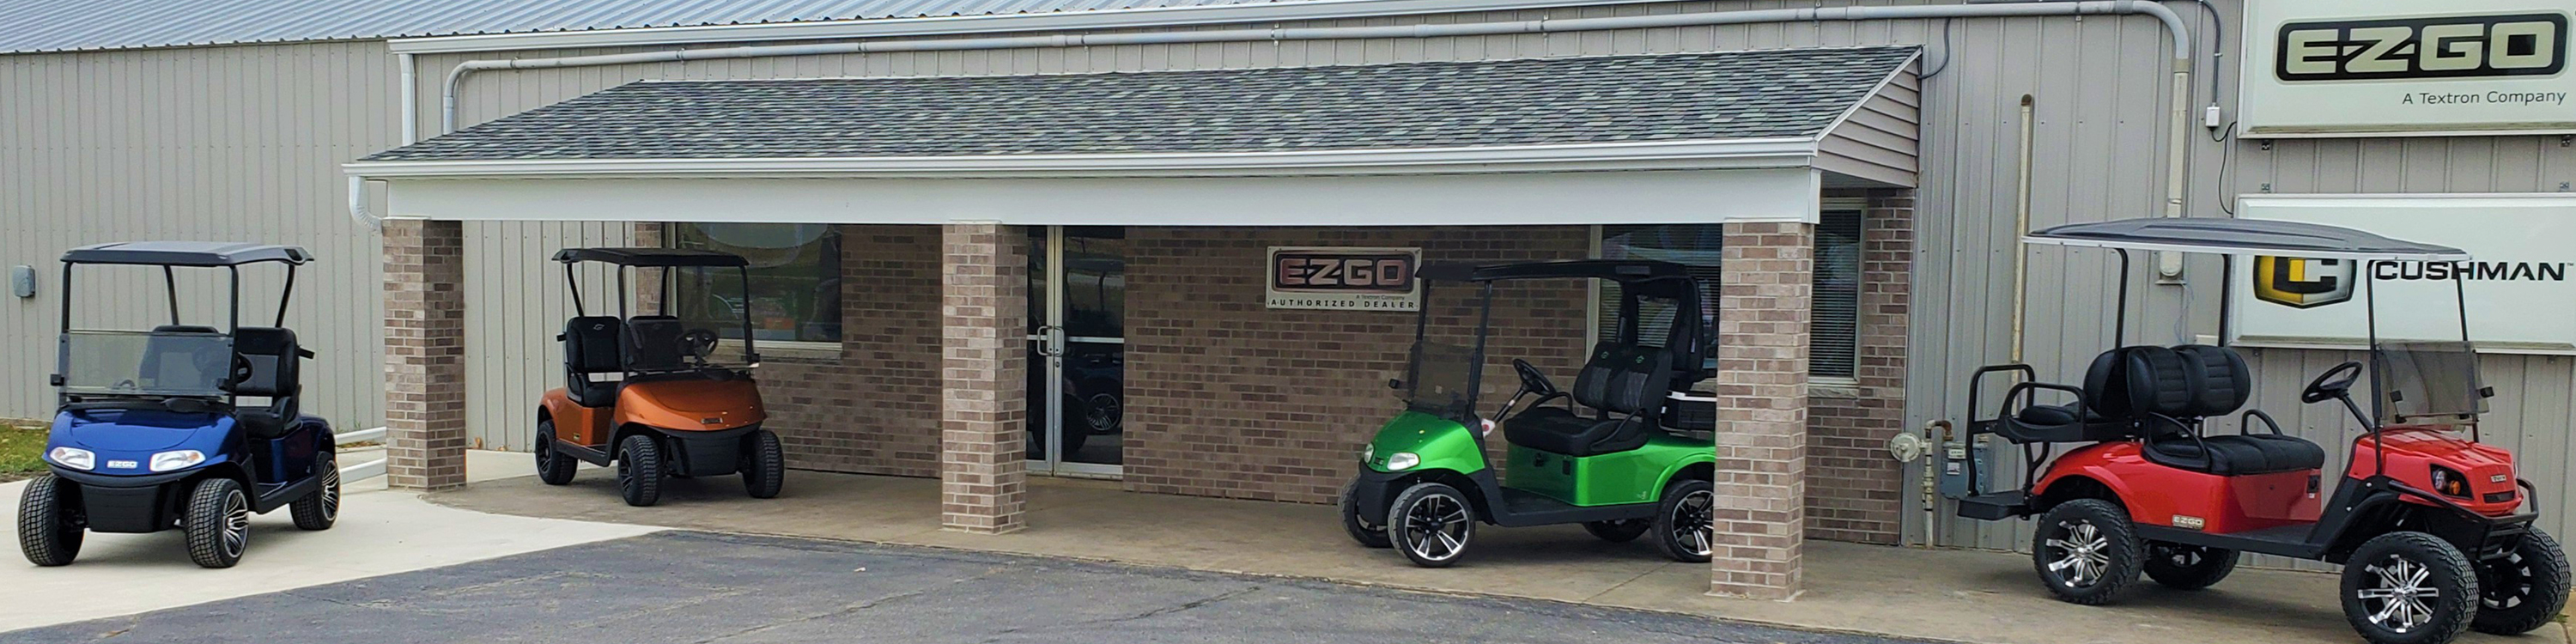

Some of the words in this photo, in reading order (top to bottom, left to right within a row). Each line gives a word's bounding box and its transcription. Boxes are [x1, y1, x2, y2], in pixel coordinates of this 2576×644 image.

[2285, 21, 2556, 75] EZGO
[2402, 93, 2414, 105] A
[2419, 92, 2480, 105] Textron
[2486, 90, 2567, 106] Company
[1279, 258, 1406, 286] EZGO
[1271, 299, 1355, 308] AUTHORIZED
[1364, 301, 1414, 309] DEALER
